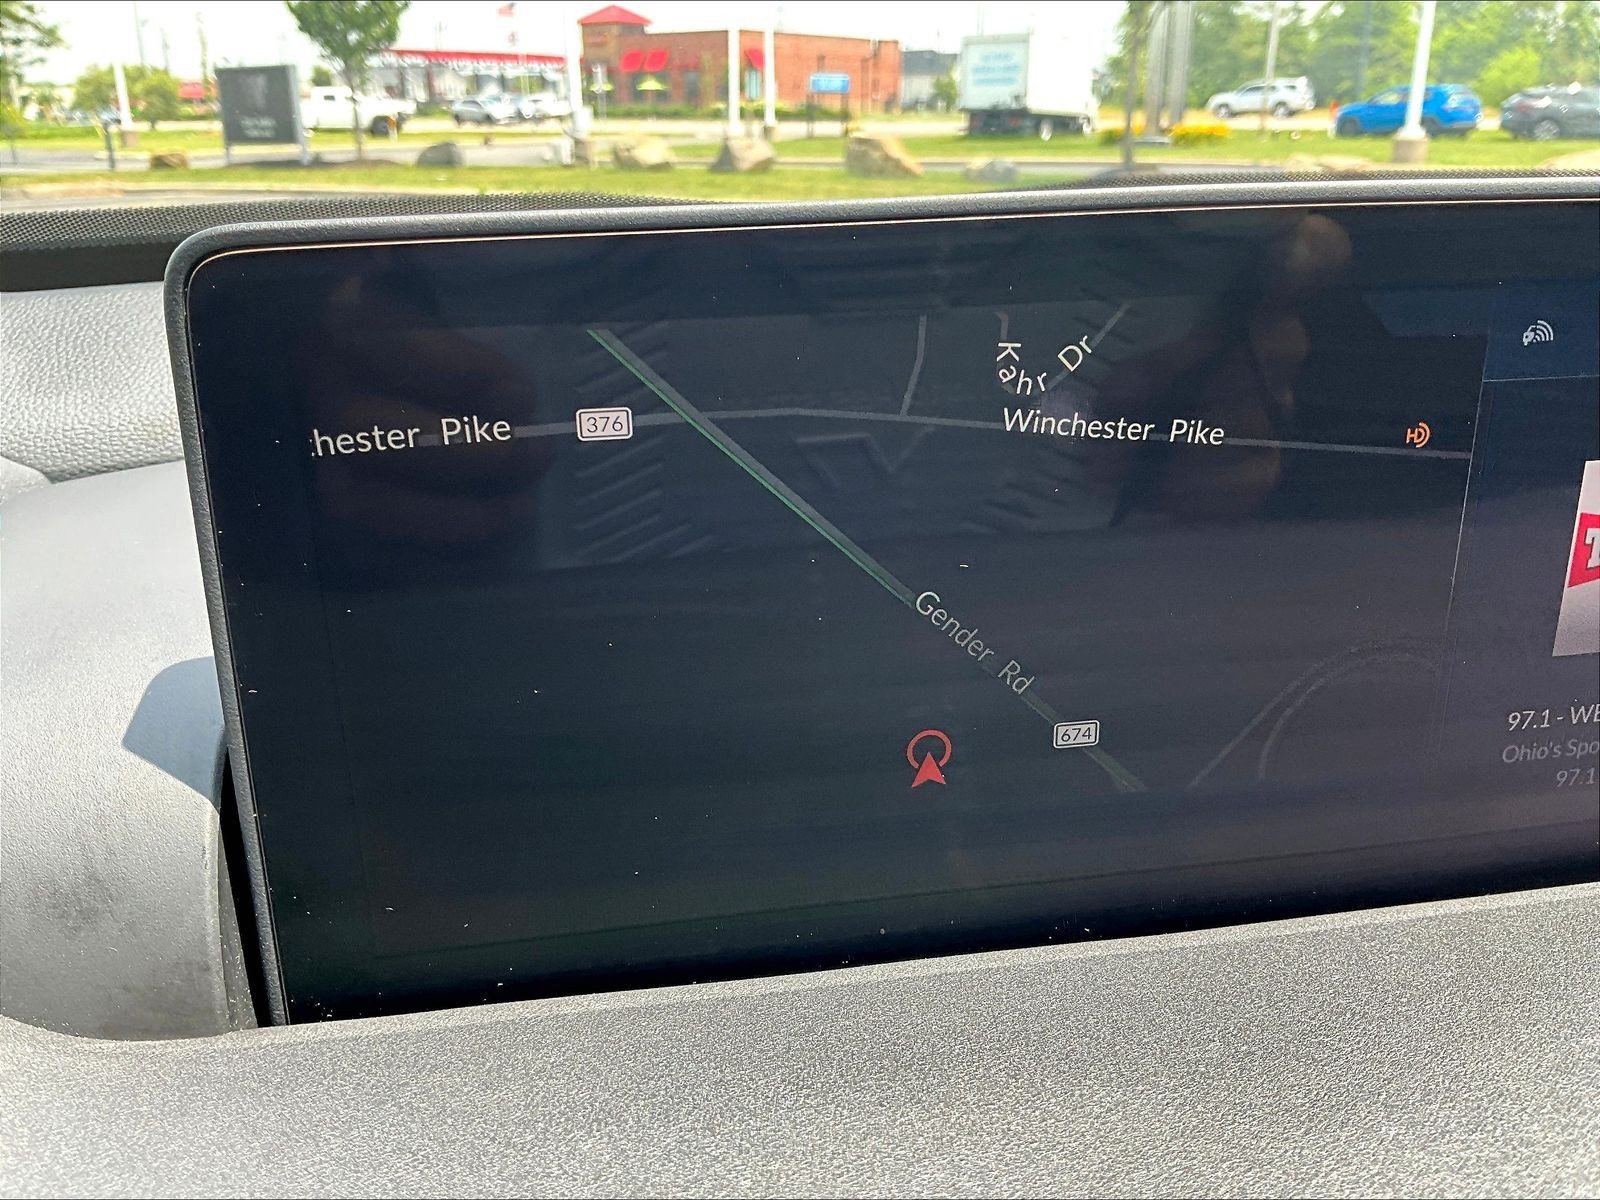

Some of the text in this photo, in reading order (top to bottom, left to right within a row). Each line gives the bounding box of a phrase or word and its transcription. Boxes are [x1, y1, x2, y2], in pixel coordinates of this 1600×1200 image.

[996, 335, 1093, 395] Kahr Dr
[309, 415, 511, 457] hester Pike
[586, 416, 624, 433] 376
[1003, 407, 1225, 446] Winchester Pike
[915, 591, 1035, 694] Gender Rd
[1508, 709, 1550, 732] 97.1
[1060, 727, 1092, 743] 674
[1502, 738, 1600, 763] Ohio's Spo
[1556, 767, 1595, 787] 97.1
